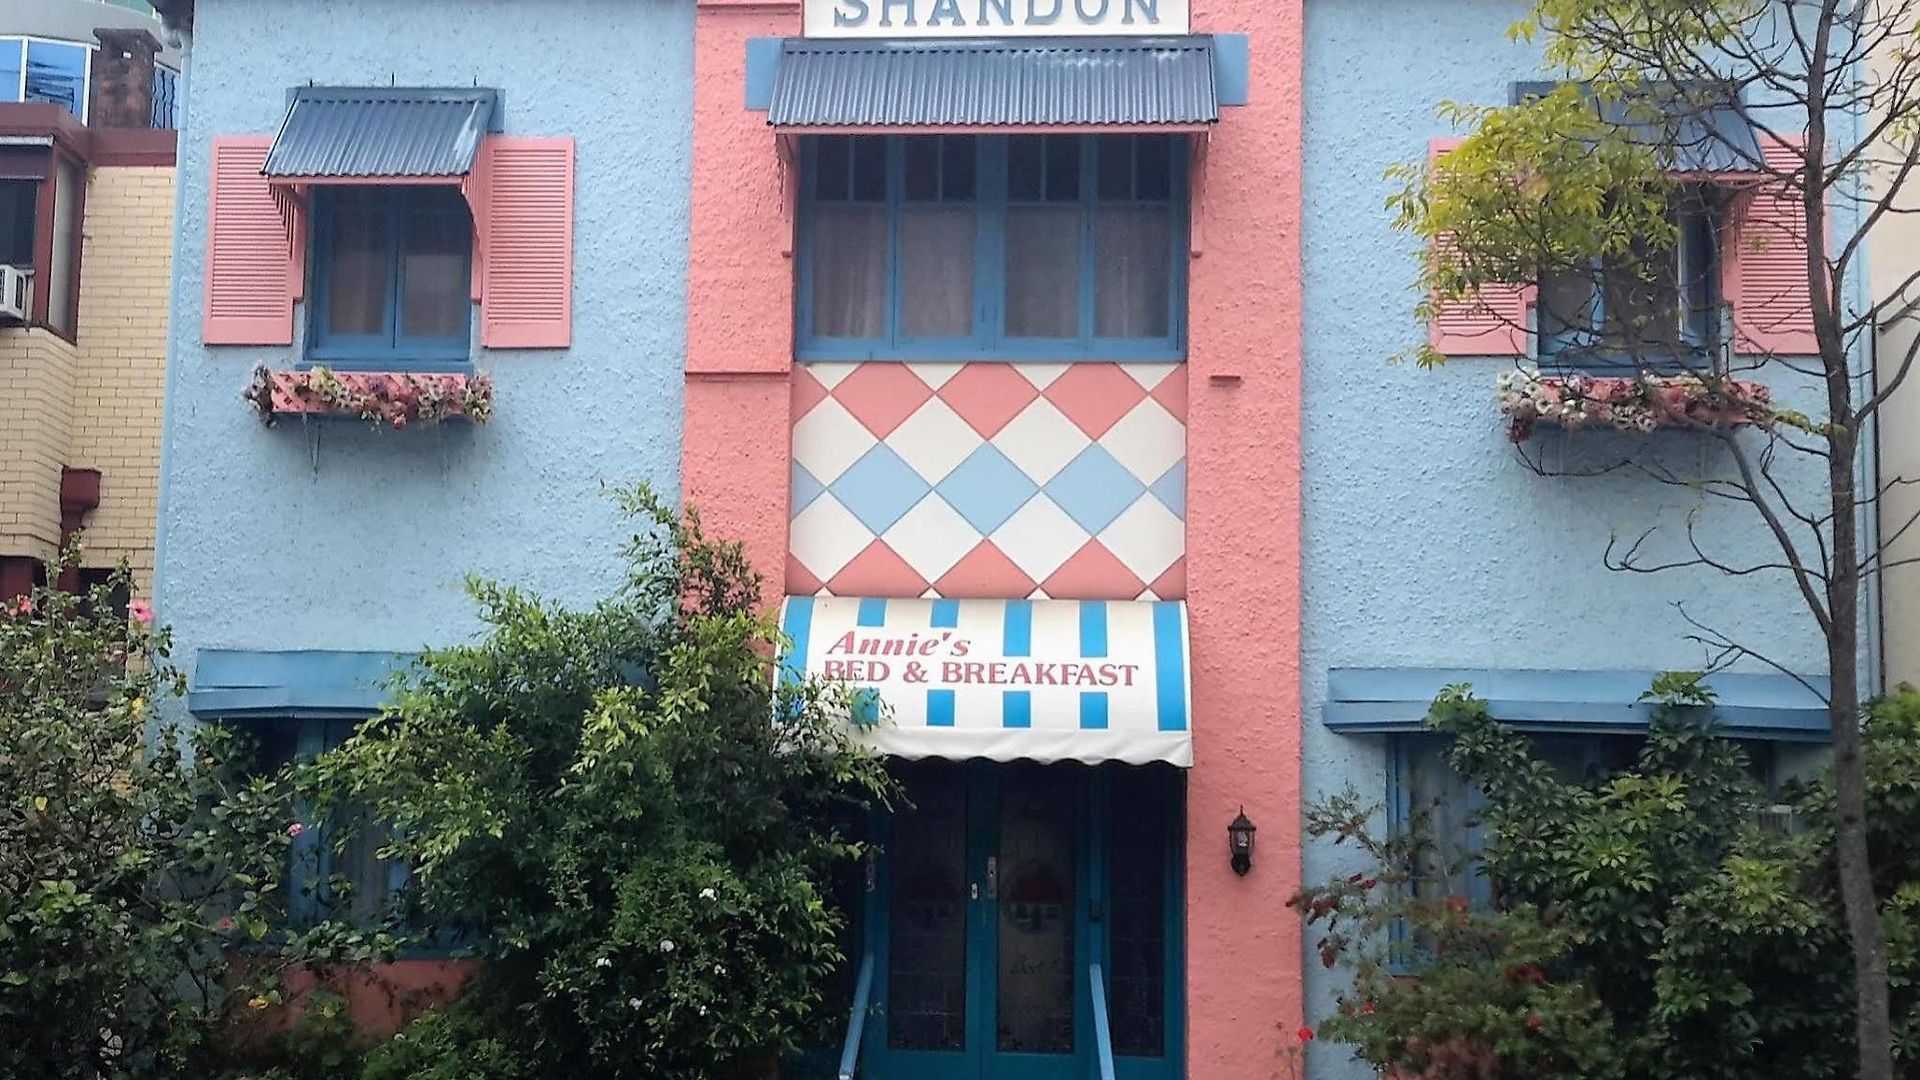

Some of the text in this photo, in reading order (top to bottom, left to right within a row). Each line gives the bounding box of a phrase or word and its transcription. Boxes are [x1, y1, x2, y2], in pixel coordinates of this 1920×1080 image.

[834, 0, 1159, 25] SHANDON
[827, 630, 971, 656] Annie's
[824, 660, 1139, 687] BED & BREAKFAST
